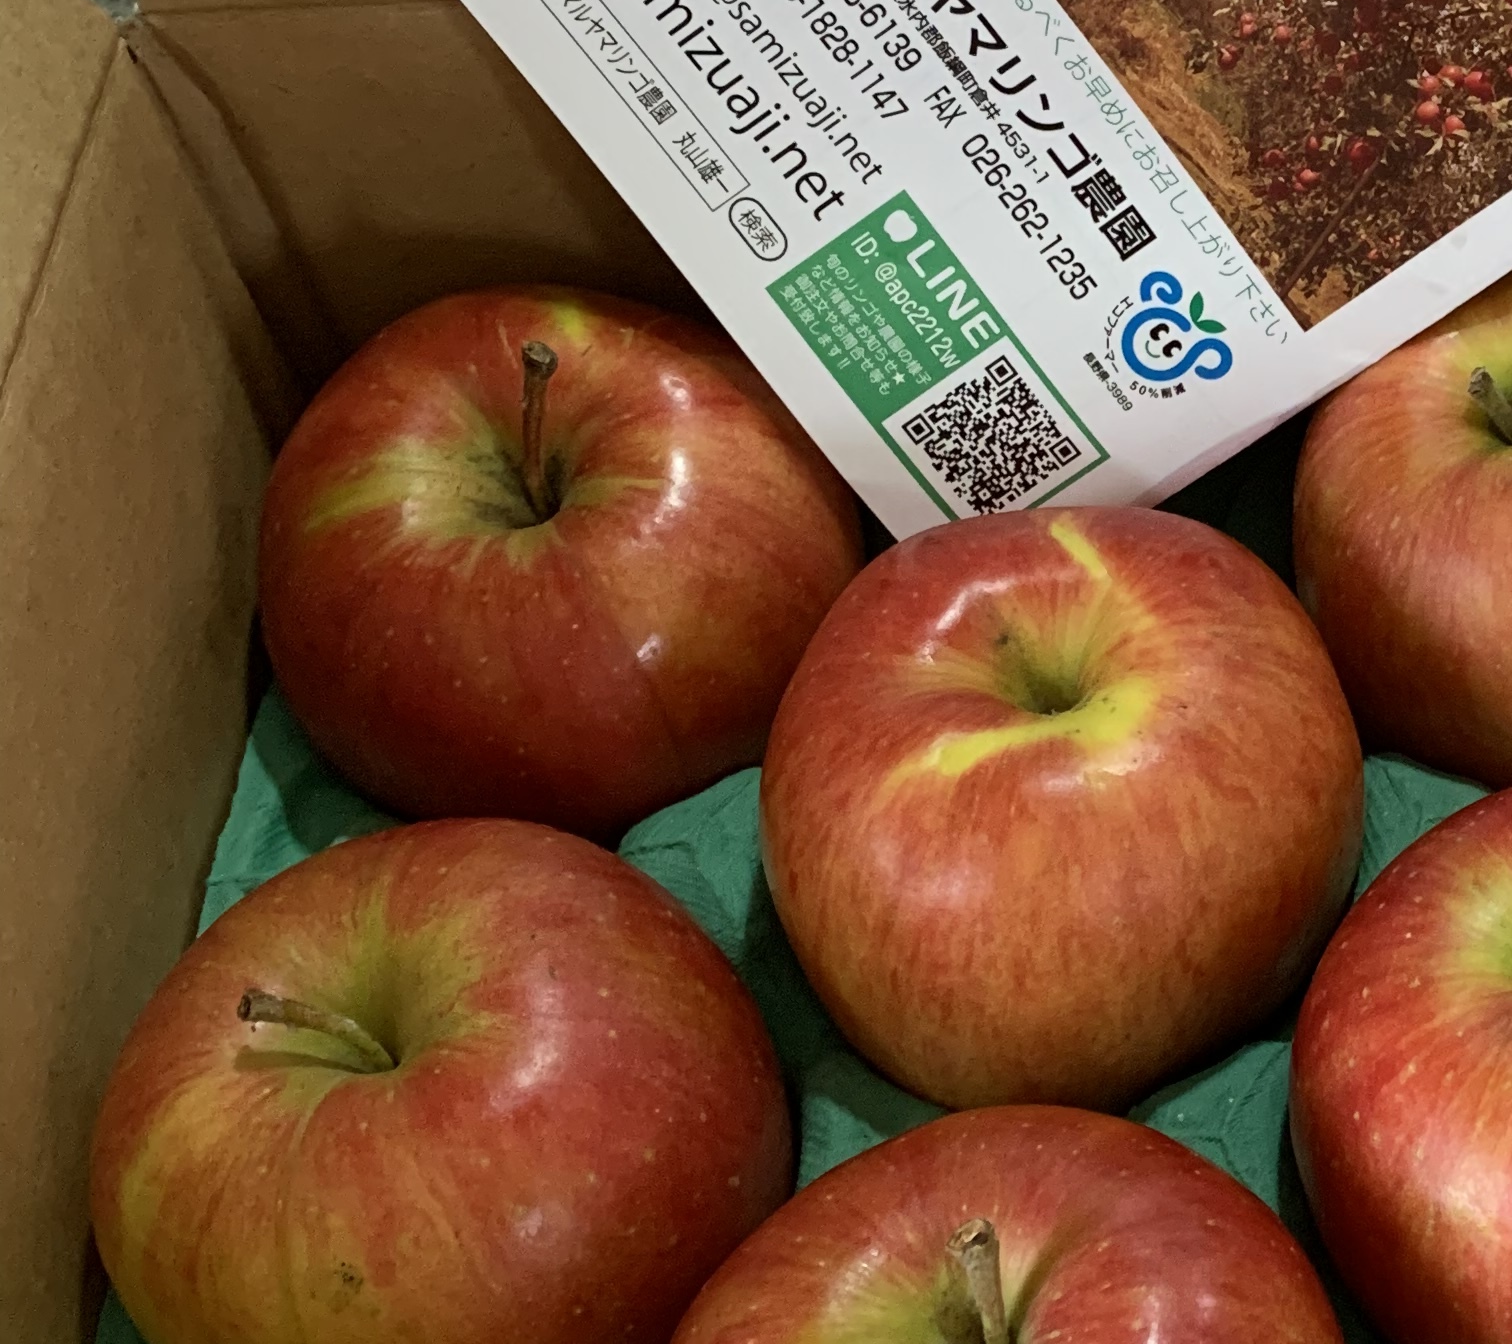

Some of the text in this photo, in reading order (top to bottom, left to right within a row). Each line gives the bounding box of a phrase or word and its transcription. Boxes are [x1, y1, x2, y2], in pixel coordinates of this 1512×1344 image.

[923, 85, 966, 128] FAX
[961, 133, 1097, 299] 026-262-1235
[991, 117, 1052, 186] 4531-1
[734, 205, 782, 253] 検索
[901, 237, 1004, 351] LINE
